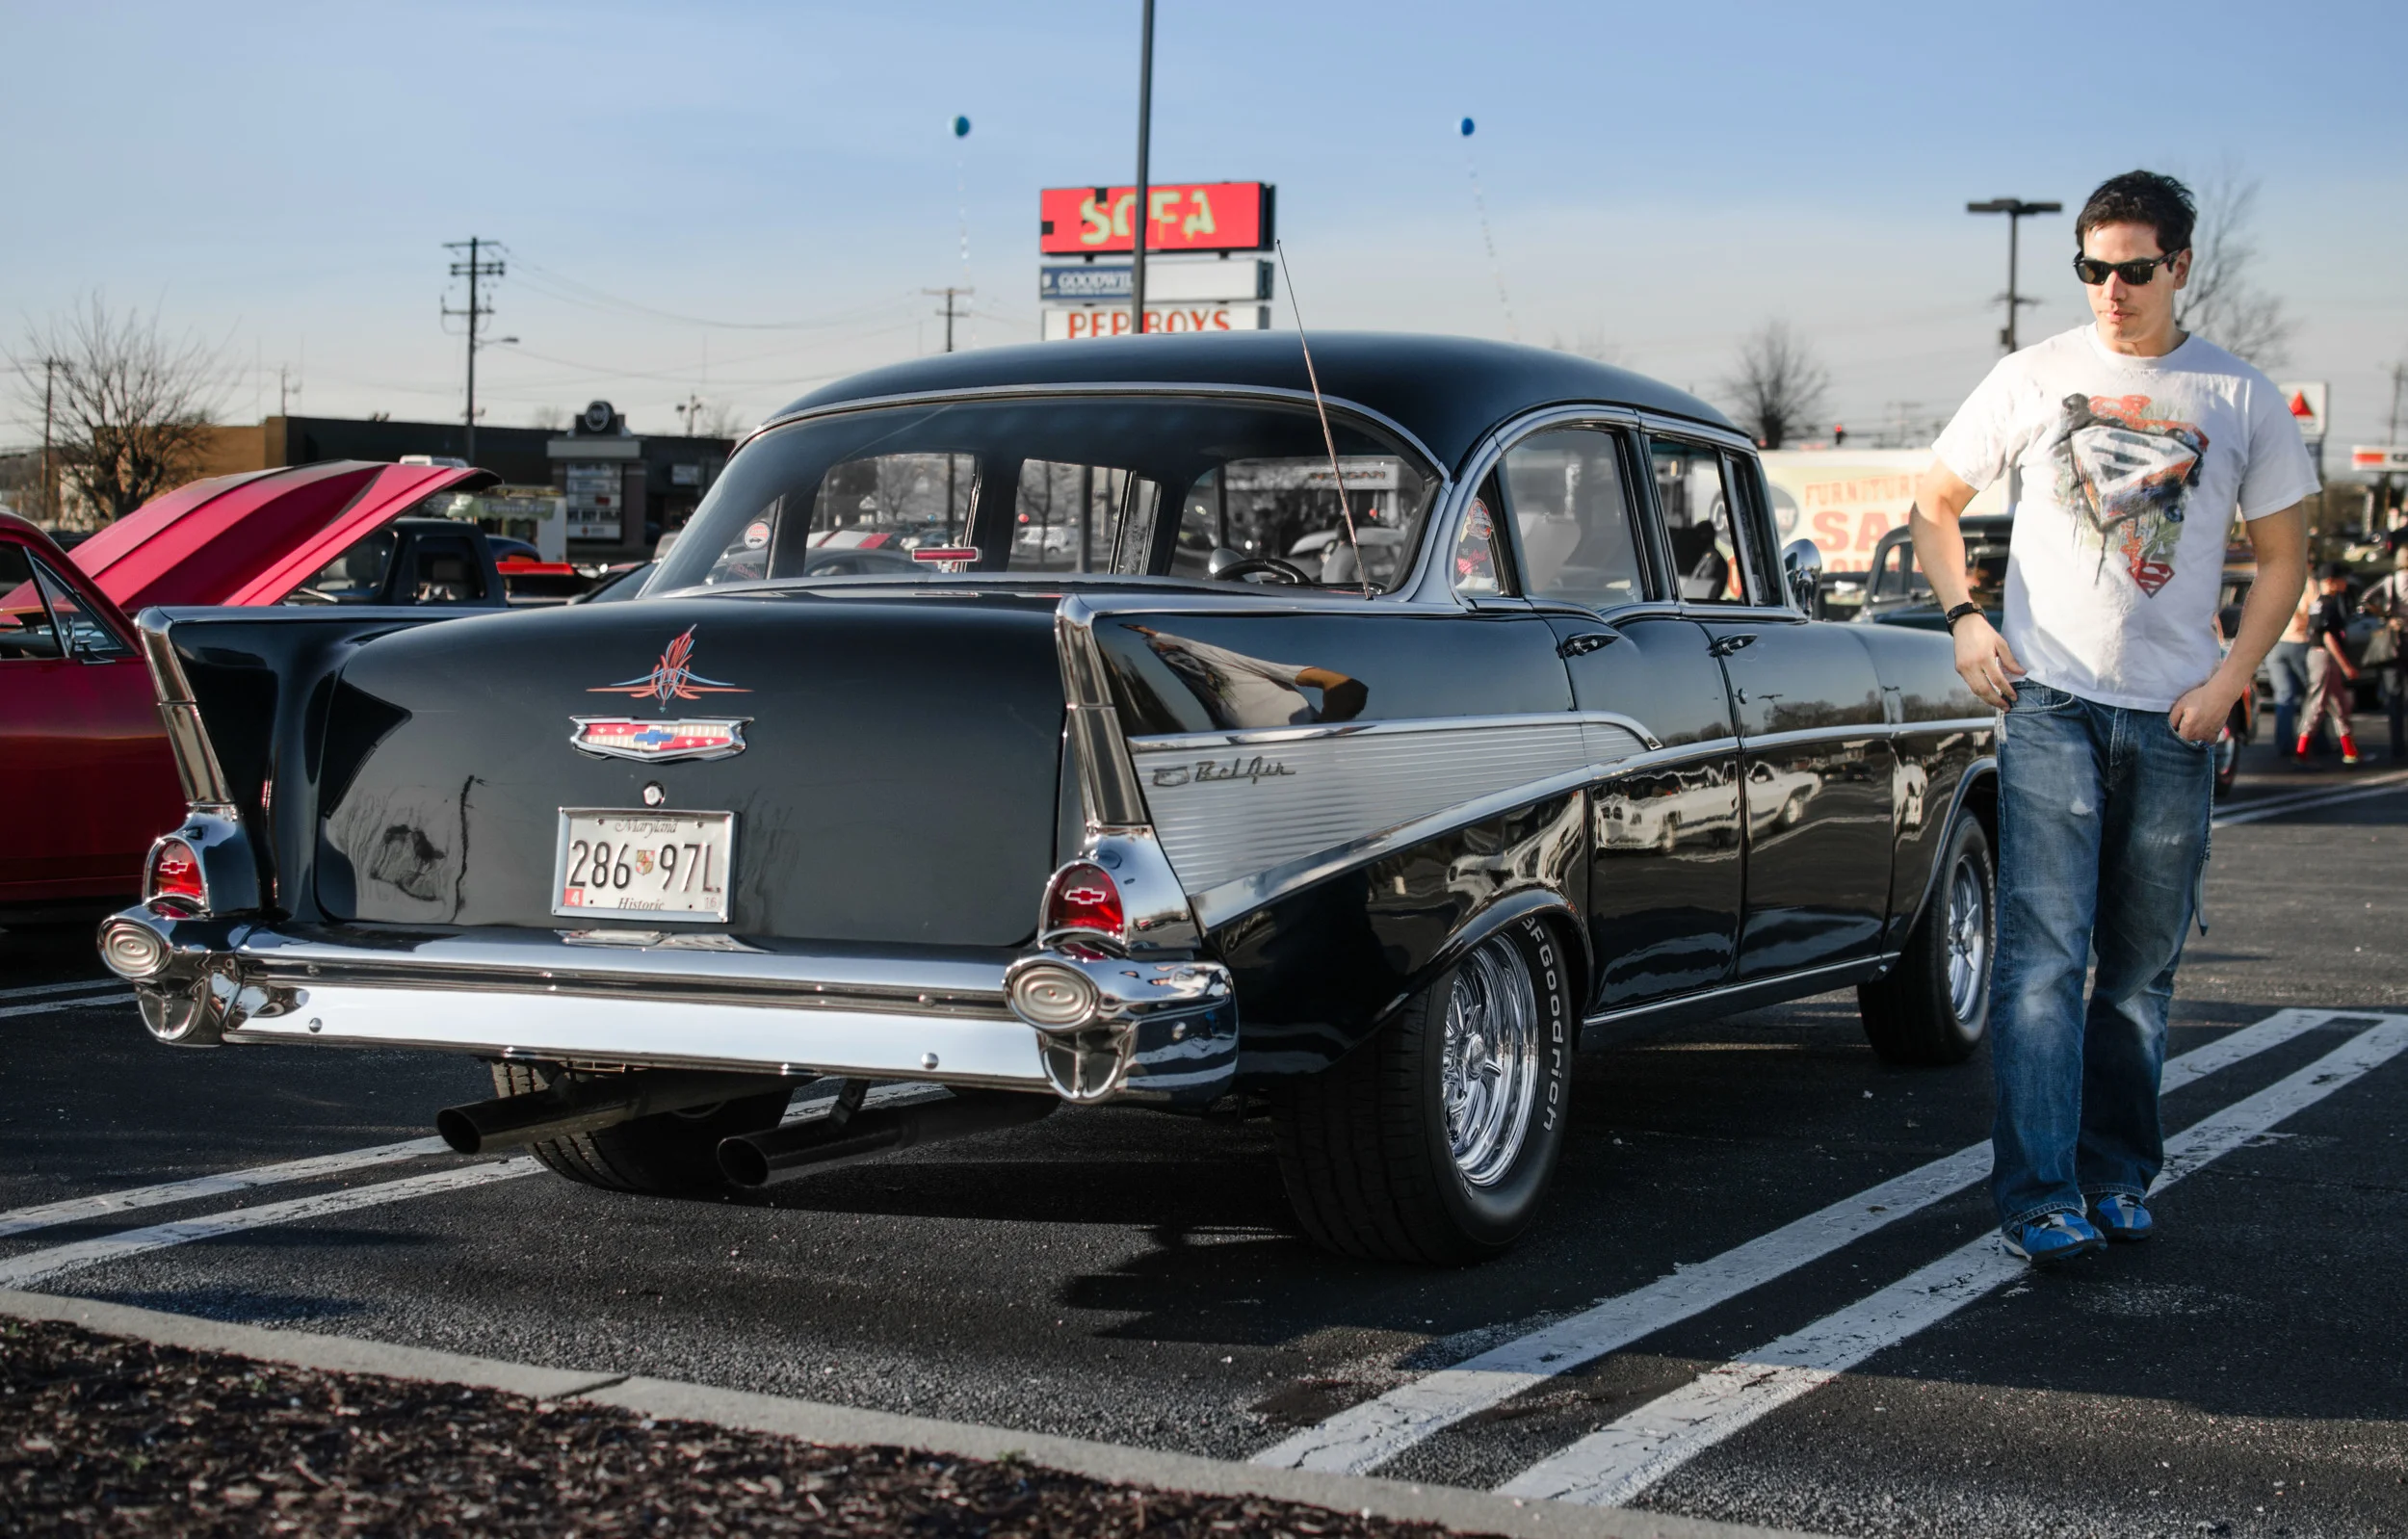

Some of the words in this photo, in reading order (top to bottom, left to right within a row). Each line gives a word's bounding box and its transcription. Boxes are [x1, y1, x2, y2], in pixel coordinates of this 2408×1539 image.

[1080, 190, 1216, 245] SOFA
[1059, 271, 1134, 289] GOODWIL
[1813, 510, 1912, 552] SA
[1194, 757, 1244, 782] Bel
[1248, 755, 1296, 785] Air
[615, 818, 678, 838] Maryland
[569, 839, 632, 890] 286
[660, 843, 721, 893] 97L
[570, 893, 580, 905] 4
[617, 897, 666, 910] Historic
[1522, 916, 1564, 1133] BFGoodrich
